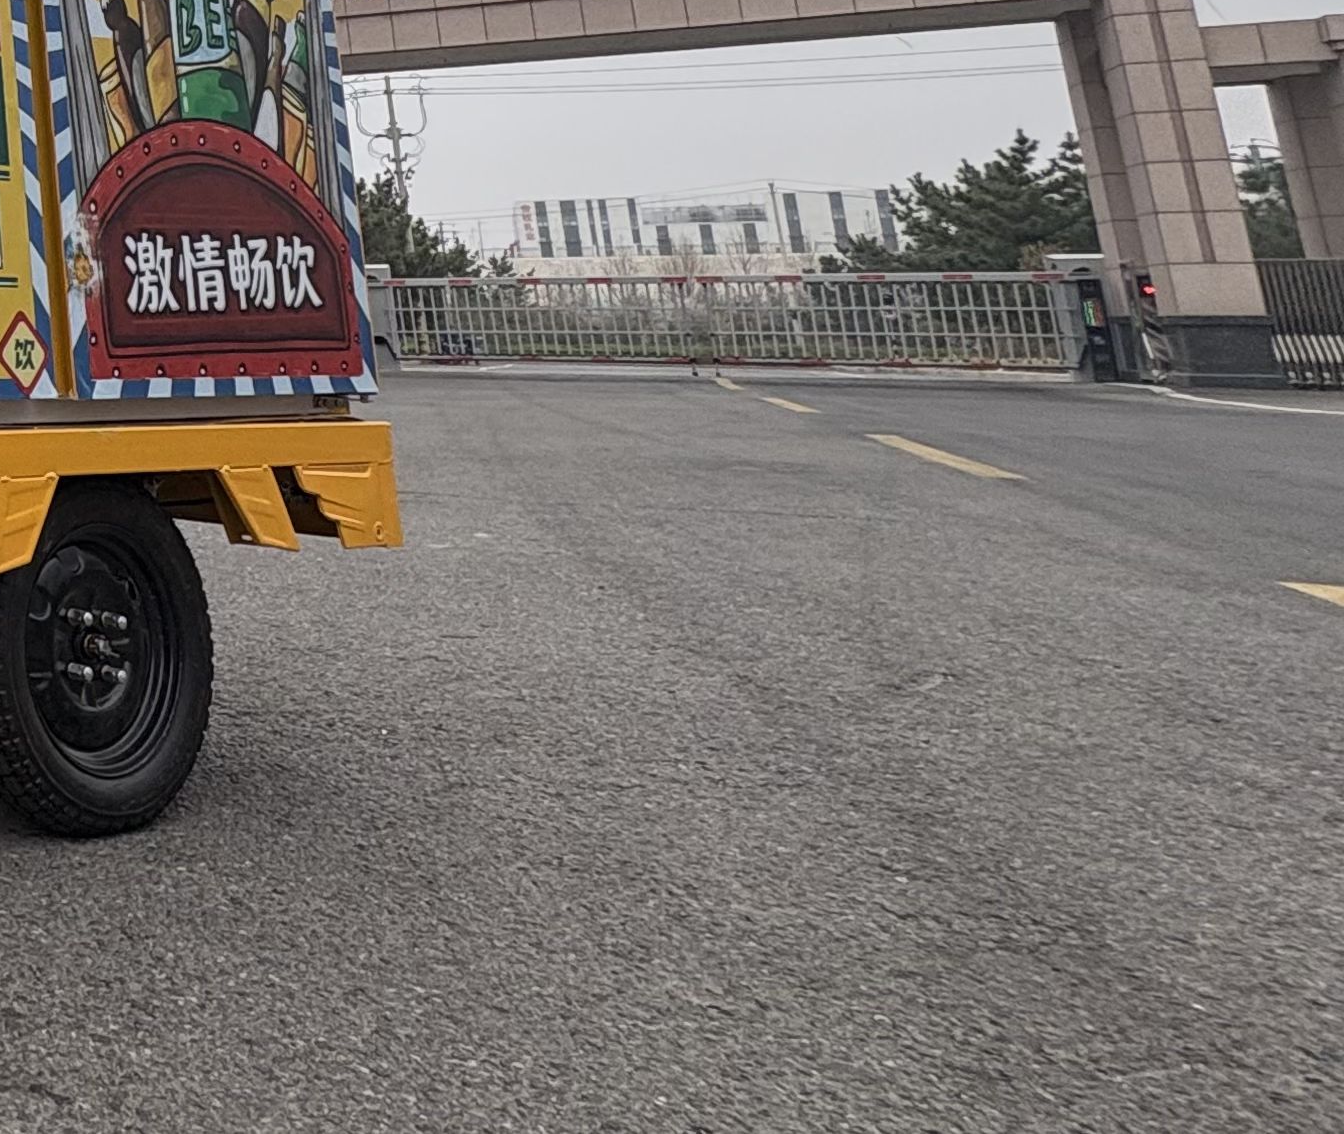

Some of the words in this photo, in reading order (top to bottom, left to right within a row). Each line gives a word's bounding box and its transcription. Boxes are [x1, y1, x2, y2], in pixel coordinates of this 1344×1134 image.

[123, 232, 325, 314] 激情畅饮
[14, 338, 36, 371] 饮
